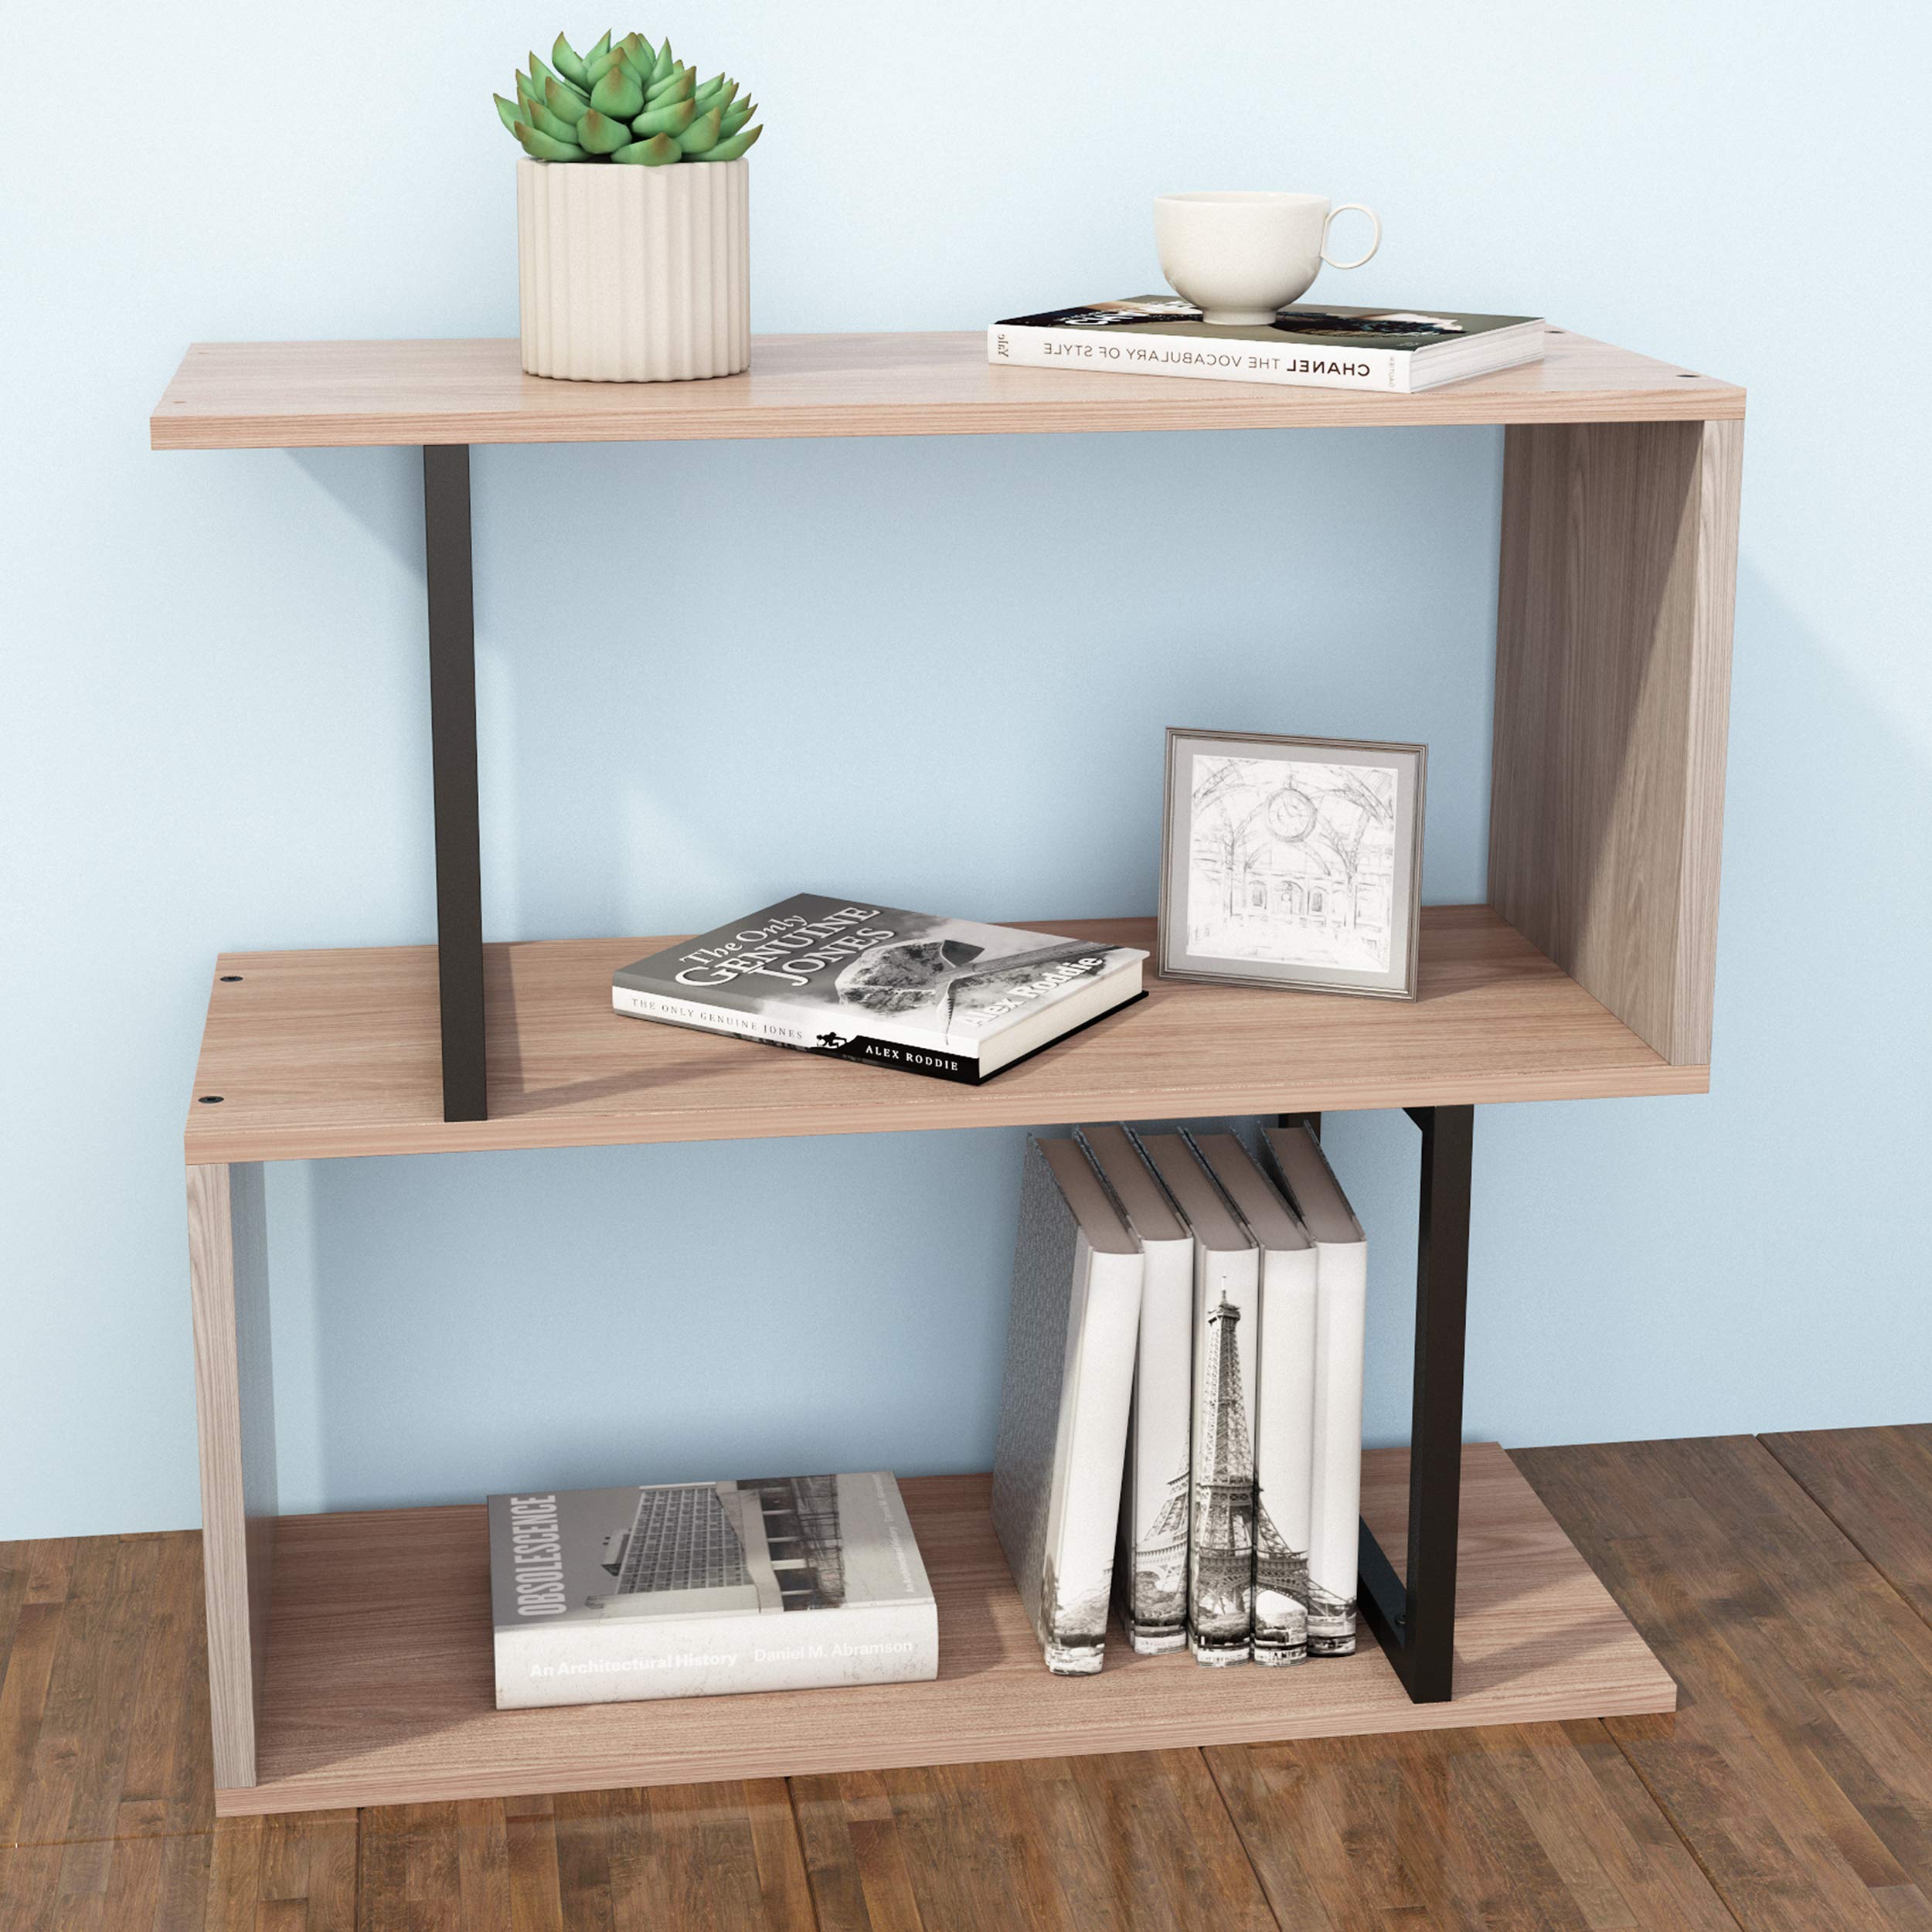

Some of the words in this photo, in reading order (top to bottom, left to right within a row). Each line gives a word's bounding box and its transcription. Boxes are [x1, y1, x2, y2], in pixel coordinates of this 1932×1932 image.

[675, 906, 882, 987] GENUINE
[679, 942, 743, 965] The
[736, 915, 808, 943] Only
[747, 927, 896, 987] JONES
[1006, 956, 1104, 999] Roddie
[631, 998, 656, 1010] THE
[662, 1004, 695, 1017] ONLY
[700, 1012, 758, 1030] GENUINE
[764, 1024, 803, 1039] JONES
[865, 1045, 900, 1060] ALEX
[905, 1052, 958, 1071] RODDIE
[510, 1495, 567, 1616] OBSOLESCENCE
[530, 1663, 554, 1678] An
[557, 1655, 672, 1676] Architectural
[675, 1651, 738, 1668] History
[754, 1646, 804, 1663] Daniel
[808, 1644, 828, 1658] M.
[832, 1640, 913, 1657] Abramson
